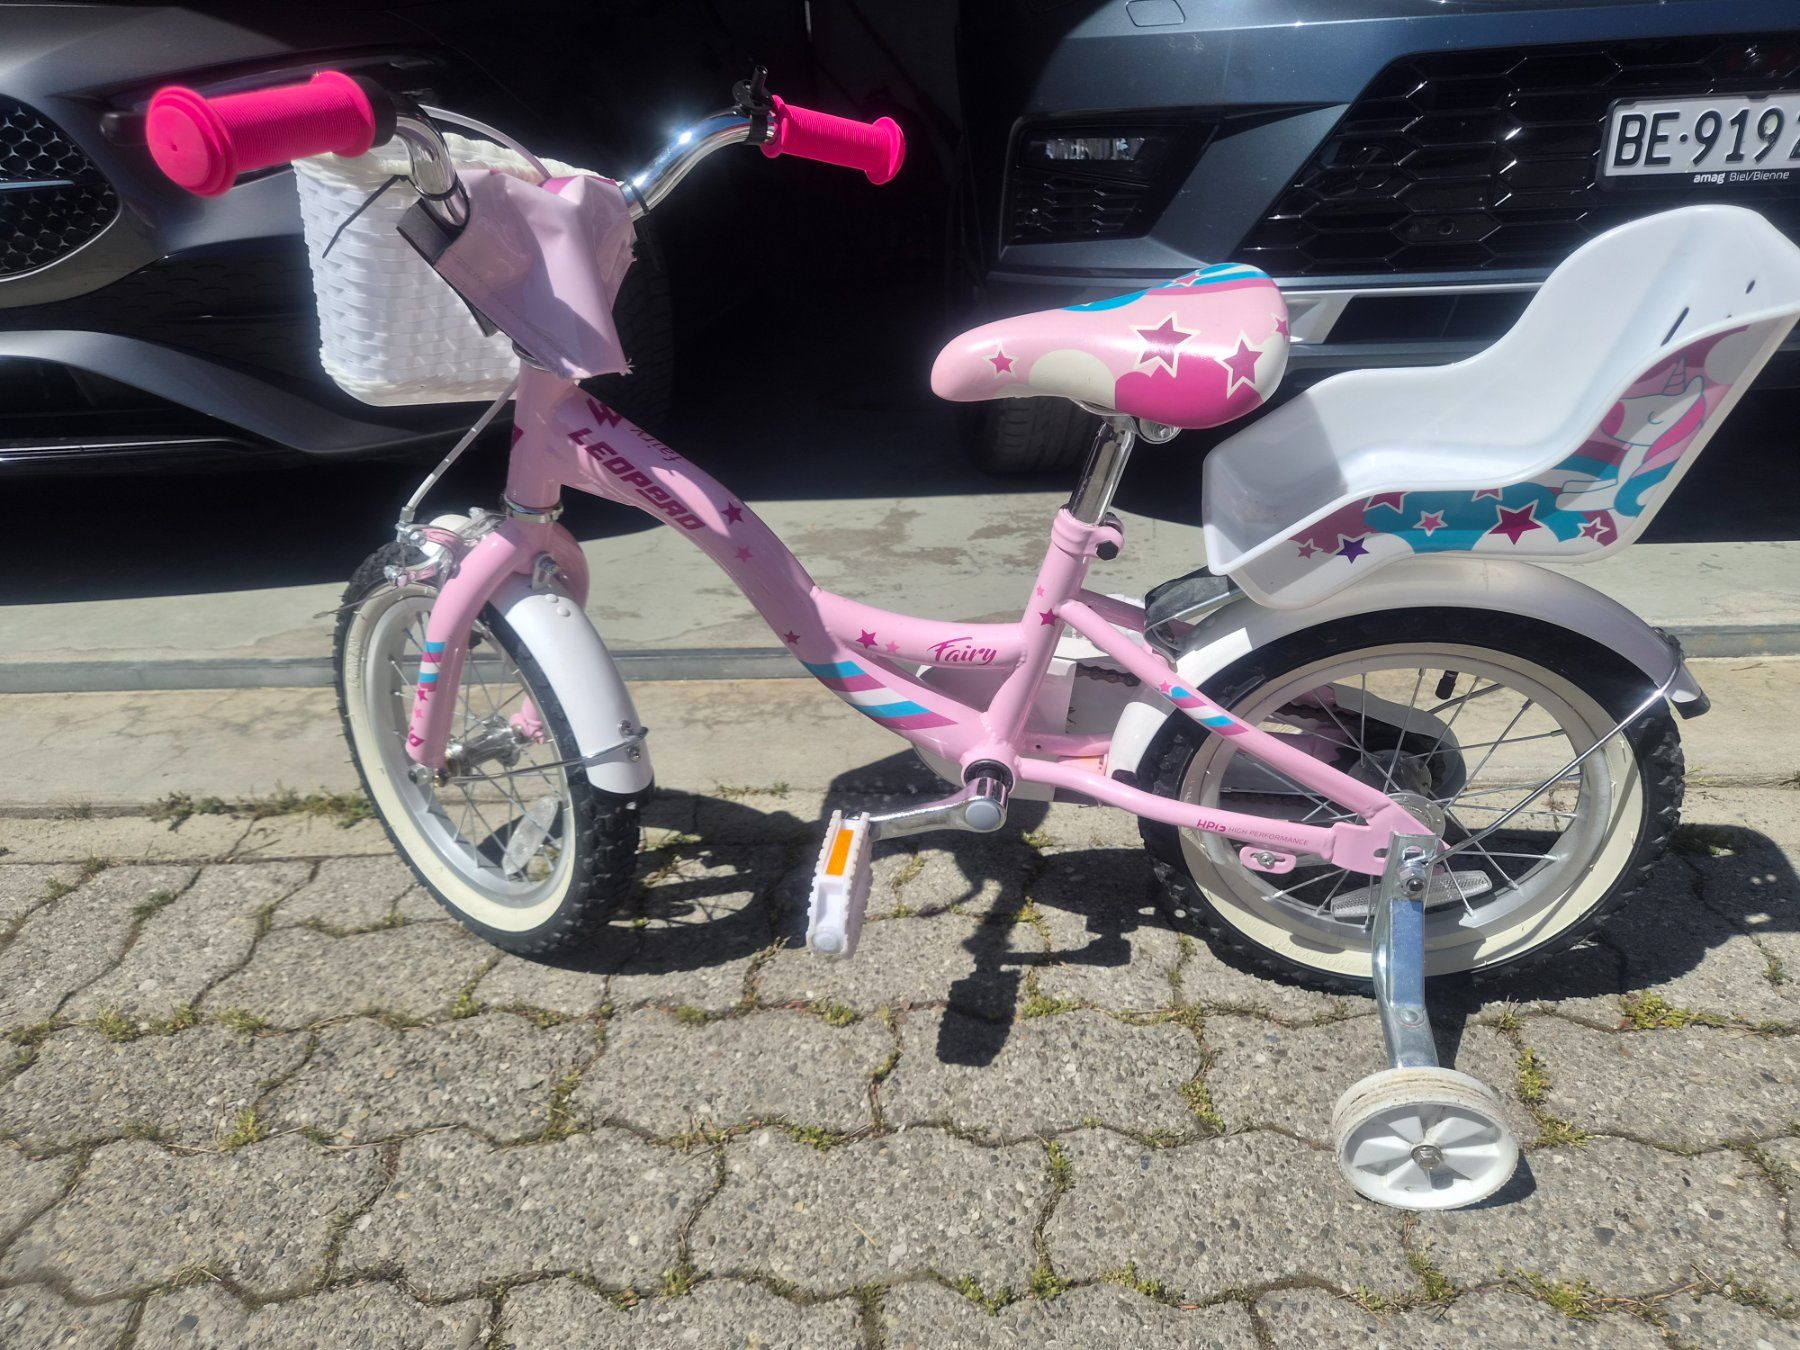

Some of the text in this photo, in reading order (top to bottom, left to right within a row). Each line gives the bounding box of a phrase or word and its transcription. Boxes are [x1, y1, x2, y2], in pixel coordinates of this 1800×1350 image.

[1693, 170, 1790, 185] amag Biel/Bienne
[567, 427, 706, 531] LEOPARD
[927, 636, 997, 666] Fairy
[1228, 826, 1249, 835] HIGH
[1250, 830, 1309, 846] PERFORMANCE
